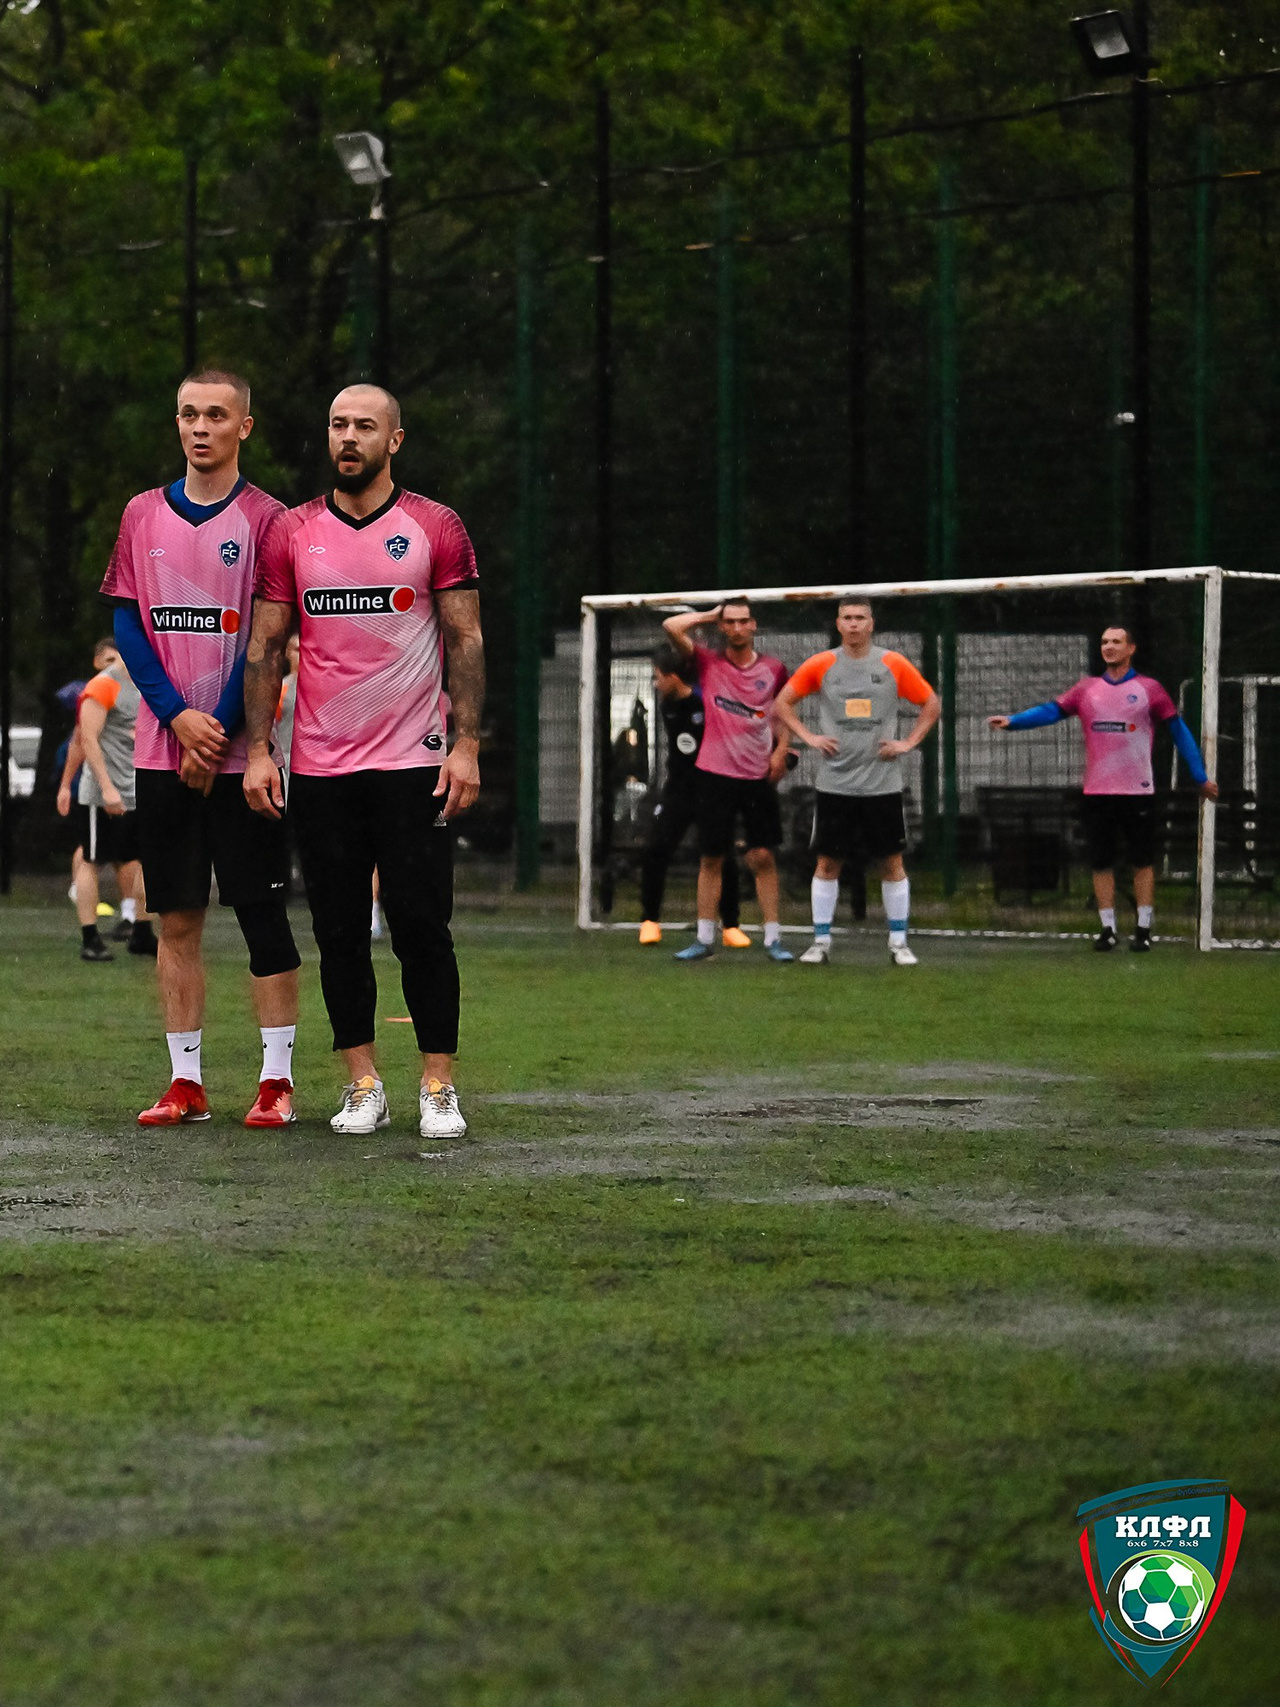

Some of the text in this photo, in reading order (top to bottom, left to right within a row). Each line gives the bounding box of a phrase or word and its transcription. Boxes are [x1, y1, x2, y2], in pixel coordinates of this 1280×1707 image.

[222, 549, 237, 558] FC
[389, 543, 406, 552] FC
[307, 593, 384, 611] Winline
[153, 611, 216, 629] Winline
